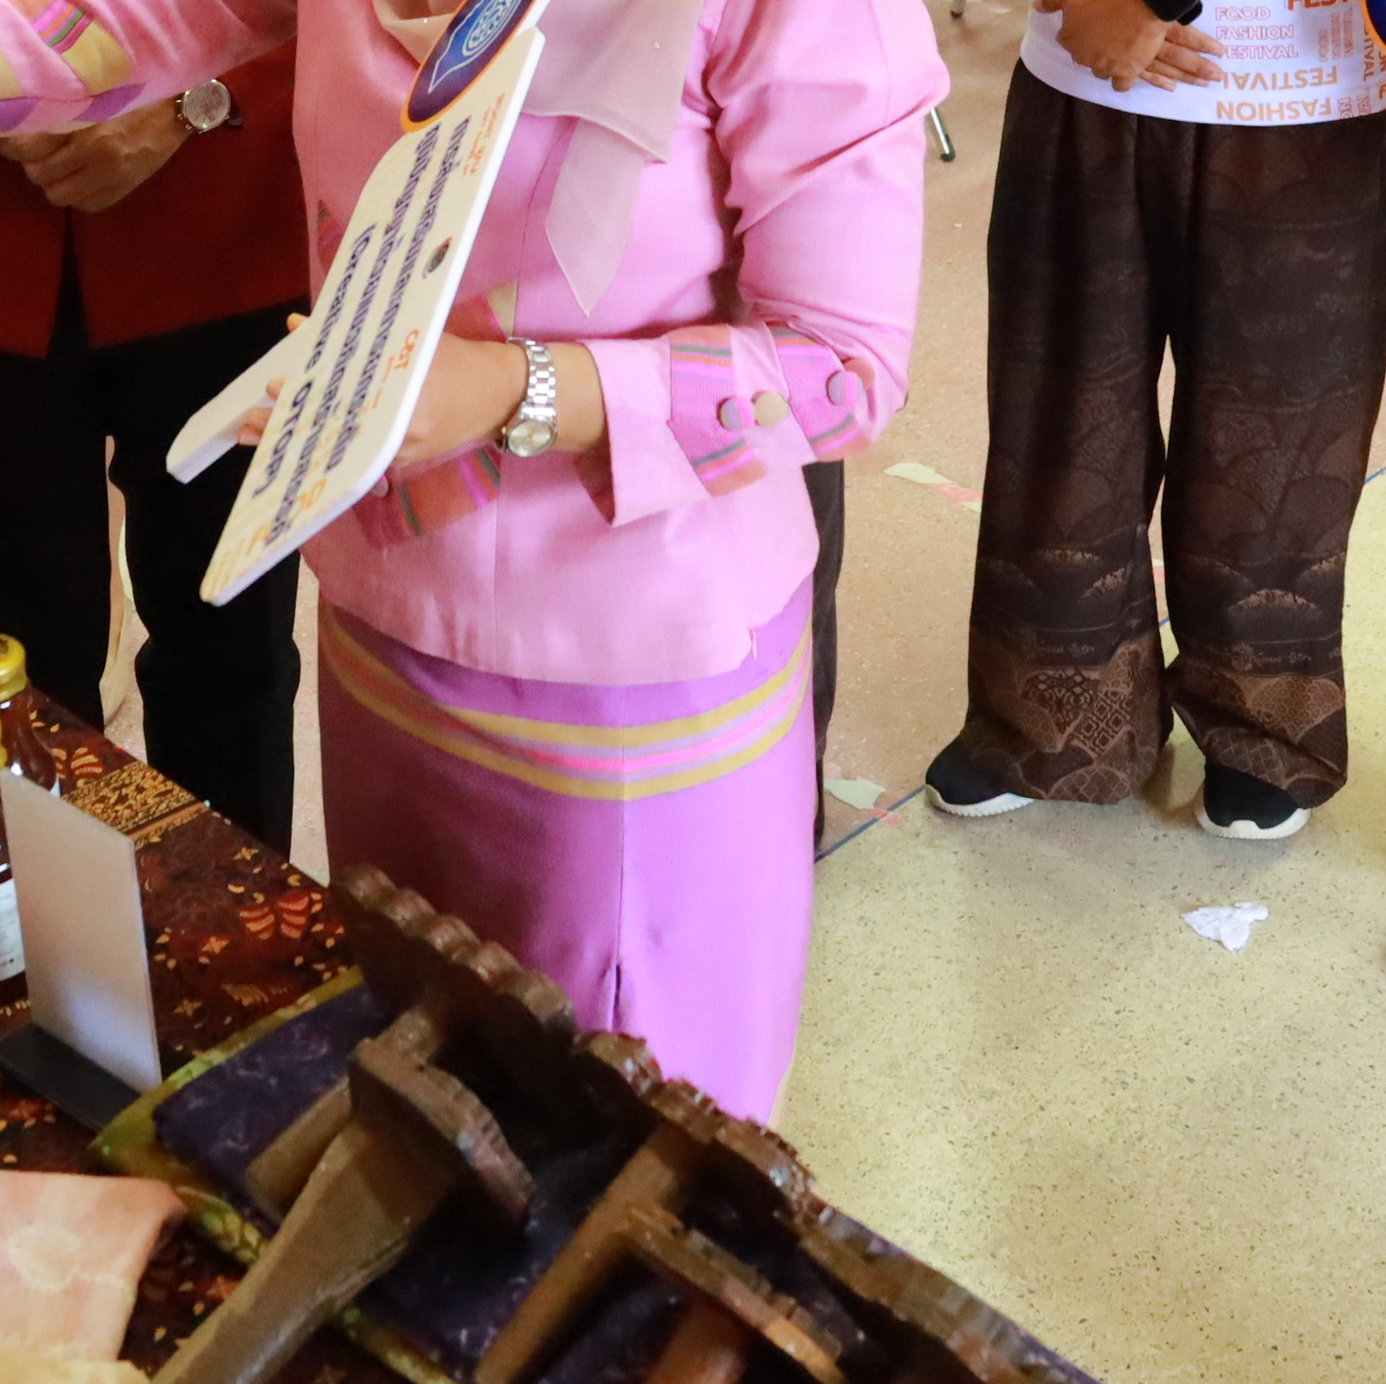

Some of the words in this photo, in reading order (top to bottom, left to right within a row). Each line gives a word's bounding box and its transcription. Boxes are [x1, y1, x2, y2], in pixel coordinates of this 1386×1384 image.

[1215, 6, 1271, 21] FOOD
[1215, 24, 1294, 40] FASHION
[1223, 44, 1299, 59] ESTIVAL
[1216, 97, 1332, 122] FASHION
